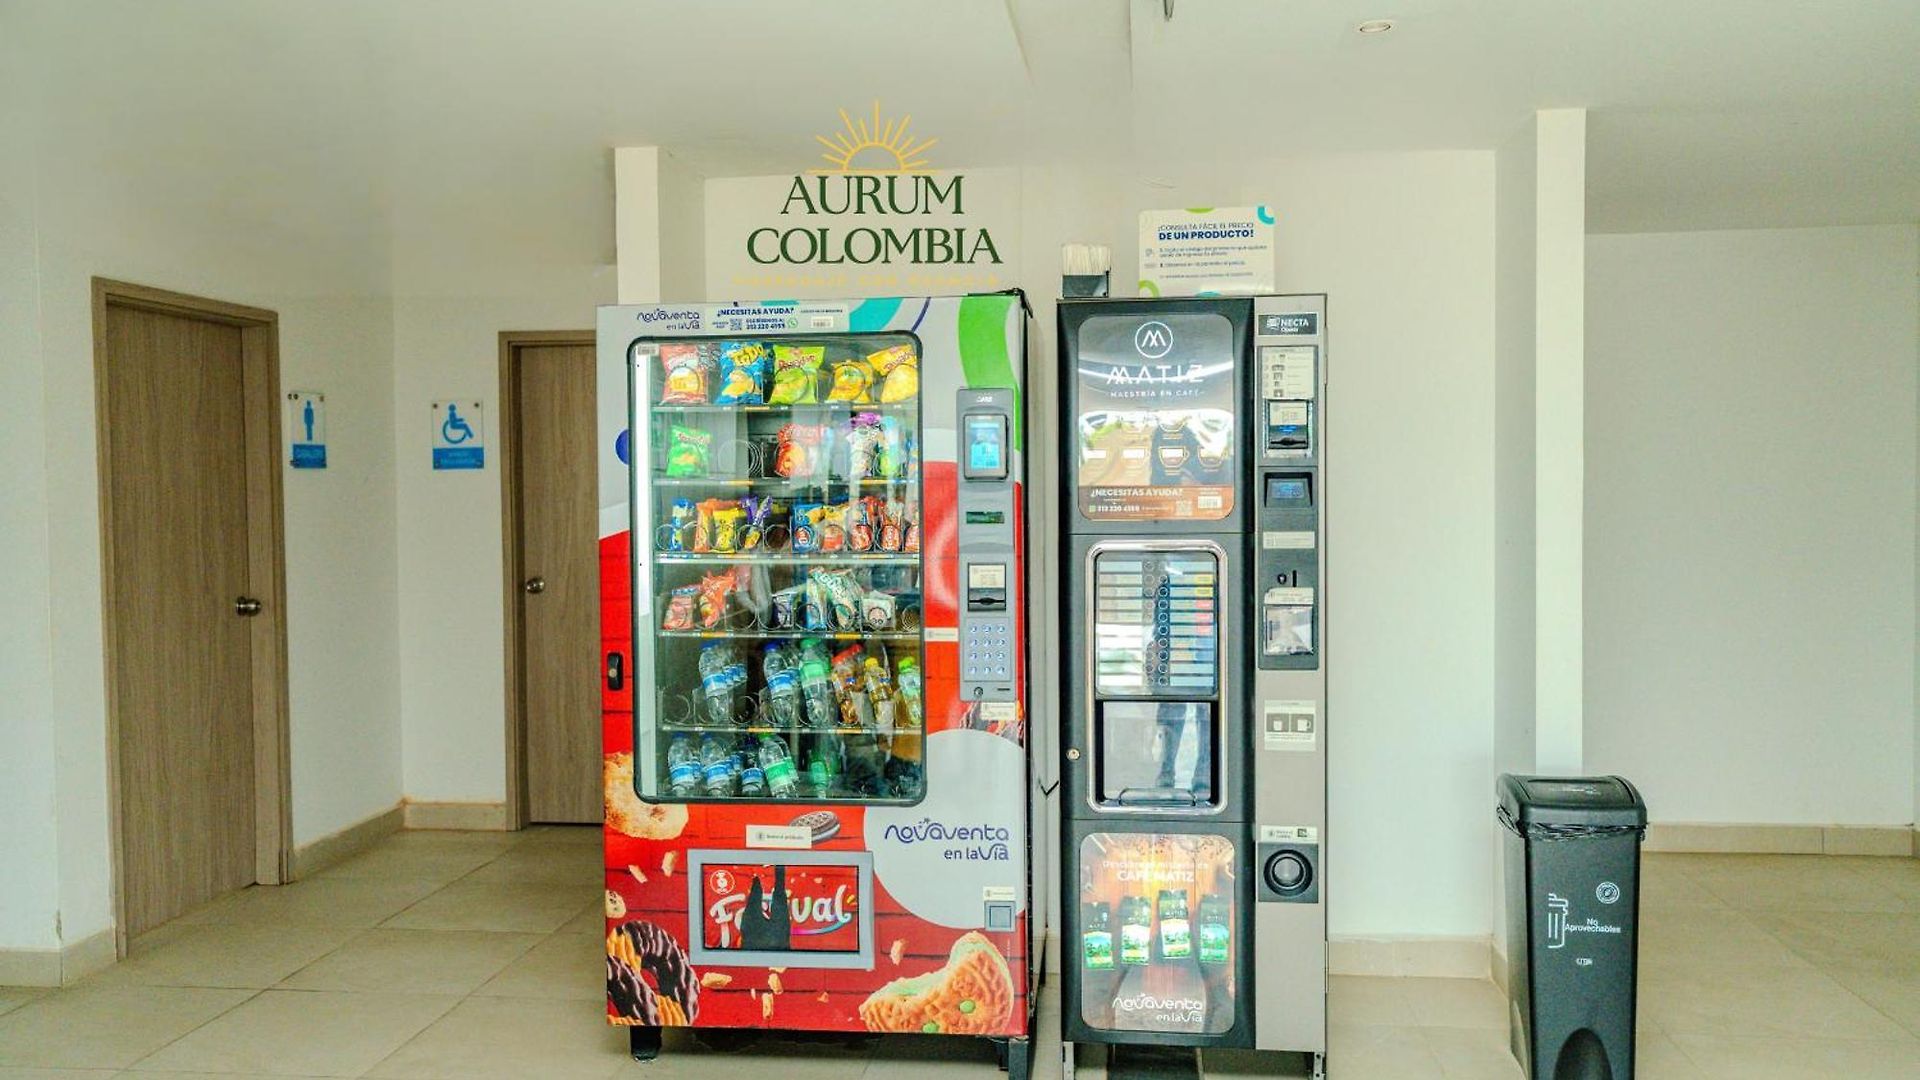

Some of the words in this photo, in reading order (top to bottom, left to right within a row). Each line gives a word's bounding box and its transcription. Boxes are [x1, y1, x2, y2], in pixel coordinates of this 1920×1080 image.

[1159, 232, 1172, 240] DE
[1174, 231, 1189, 240] UN
[1191, 229, 1255, 239] PRODUCTO!
[1280, 318, 1310, 327] NECTA
[1106, 364, 1204, 385] MATIZ
[1090, 488, 1144, 498] ¿NECESITAS
[1145, 487, 1184, 497] AYUDA?
[944, 849, 962, 860] en
[1586, 917, 1598, 926] No
[1157, 1013, 1171, 1021] en
